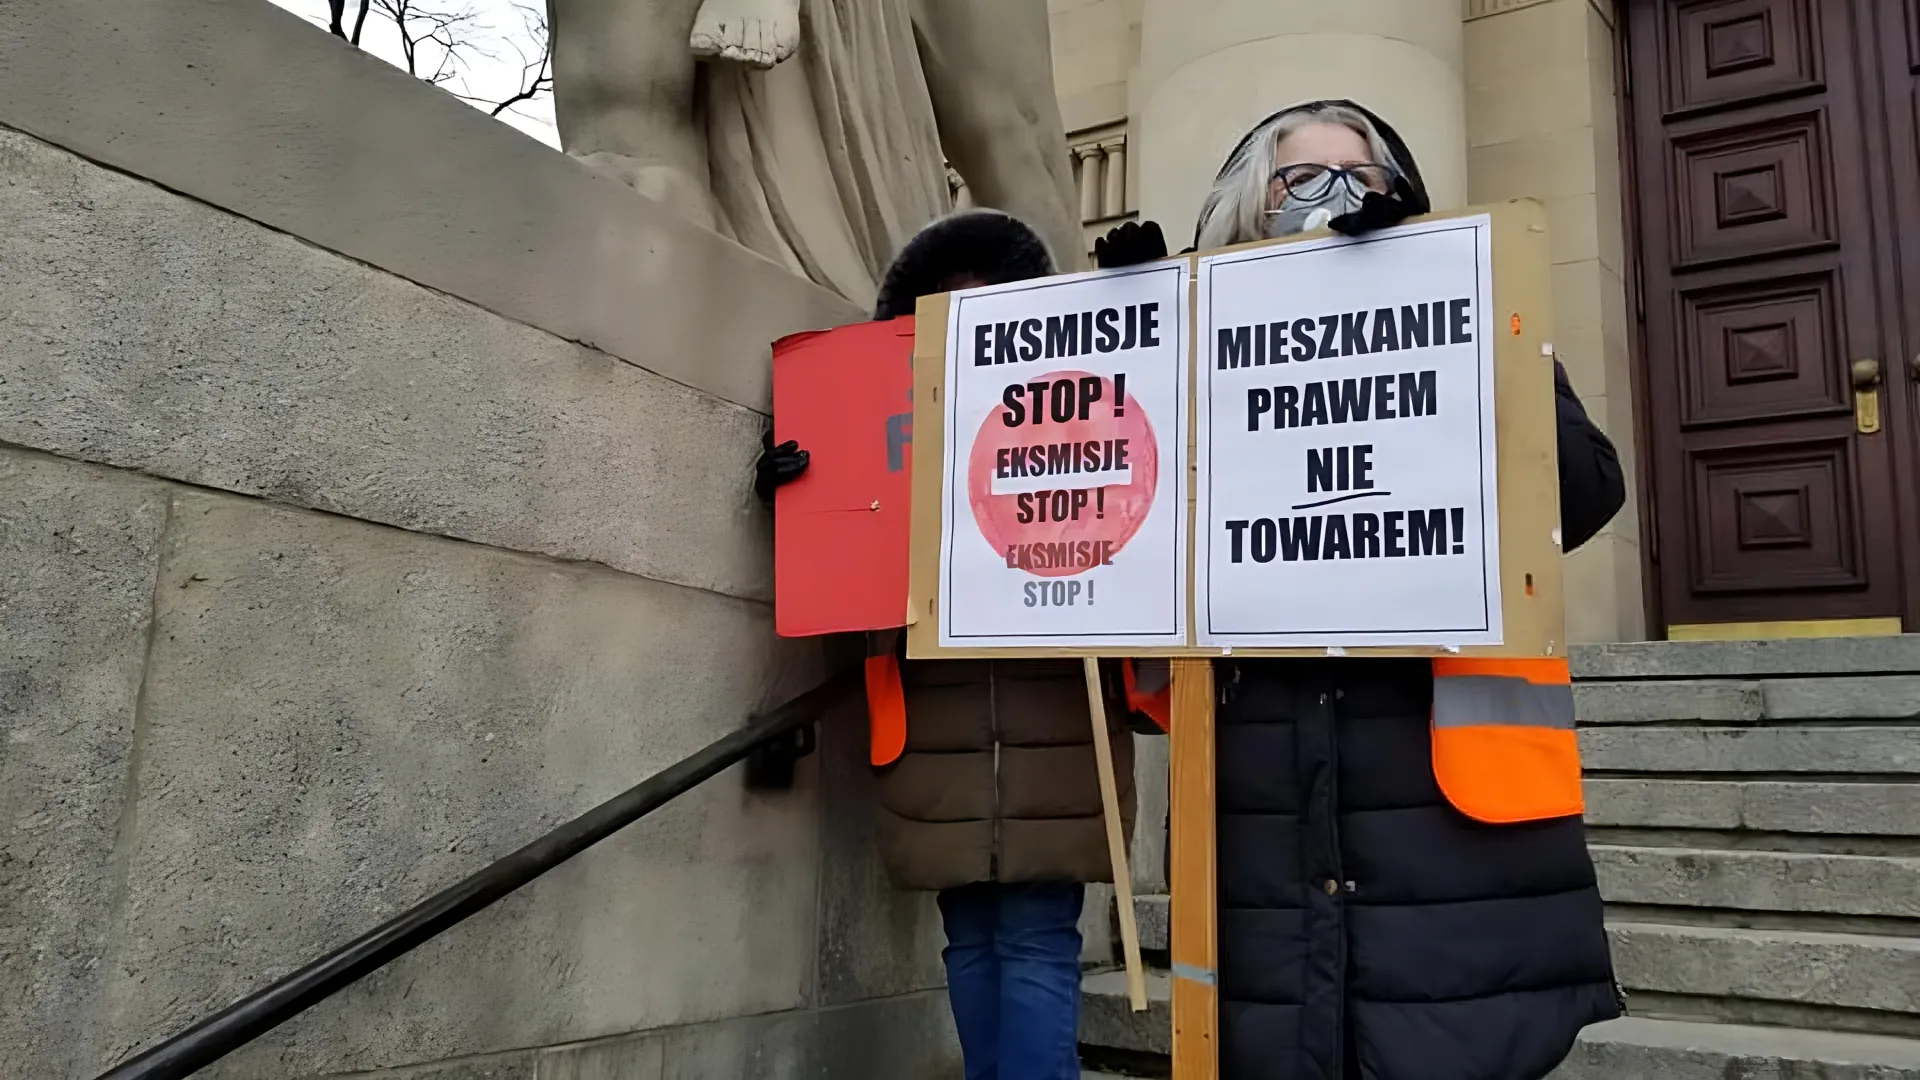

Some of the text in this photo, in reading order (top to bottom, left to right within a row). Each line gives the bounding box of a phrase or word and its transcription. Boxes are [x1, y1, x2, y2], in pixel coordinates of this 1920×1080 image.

[974, 302, 1159, 366] EKSMISJE
[1218, 298, 1472, 370] MIESZKANIE
[1247, 371, 1437, 431] PRAWEM
[996, 439, 1129, 479] EKSMISJE
[1307, 445, 1374, 493] NIE
[1006, 540, 1113, 569] EKSMISJE
[1225, 507, 1465, 564] TOWAREM!
